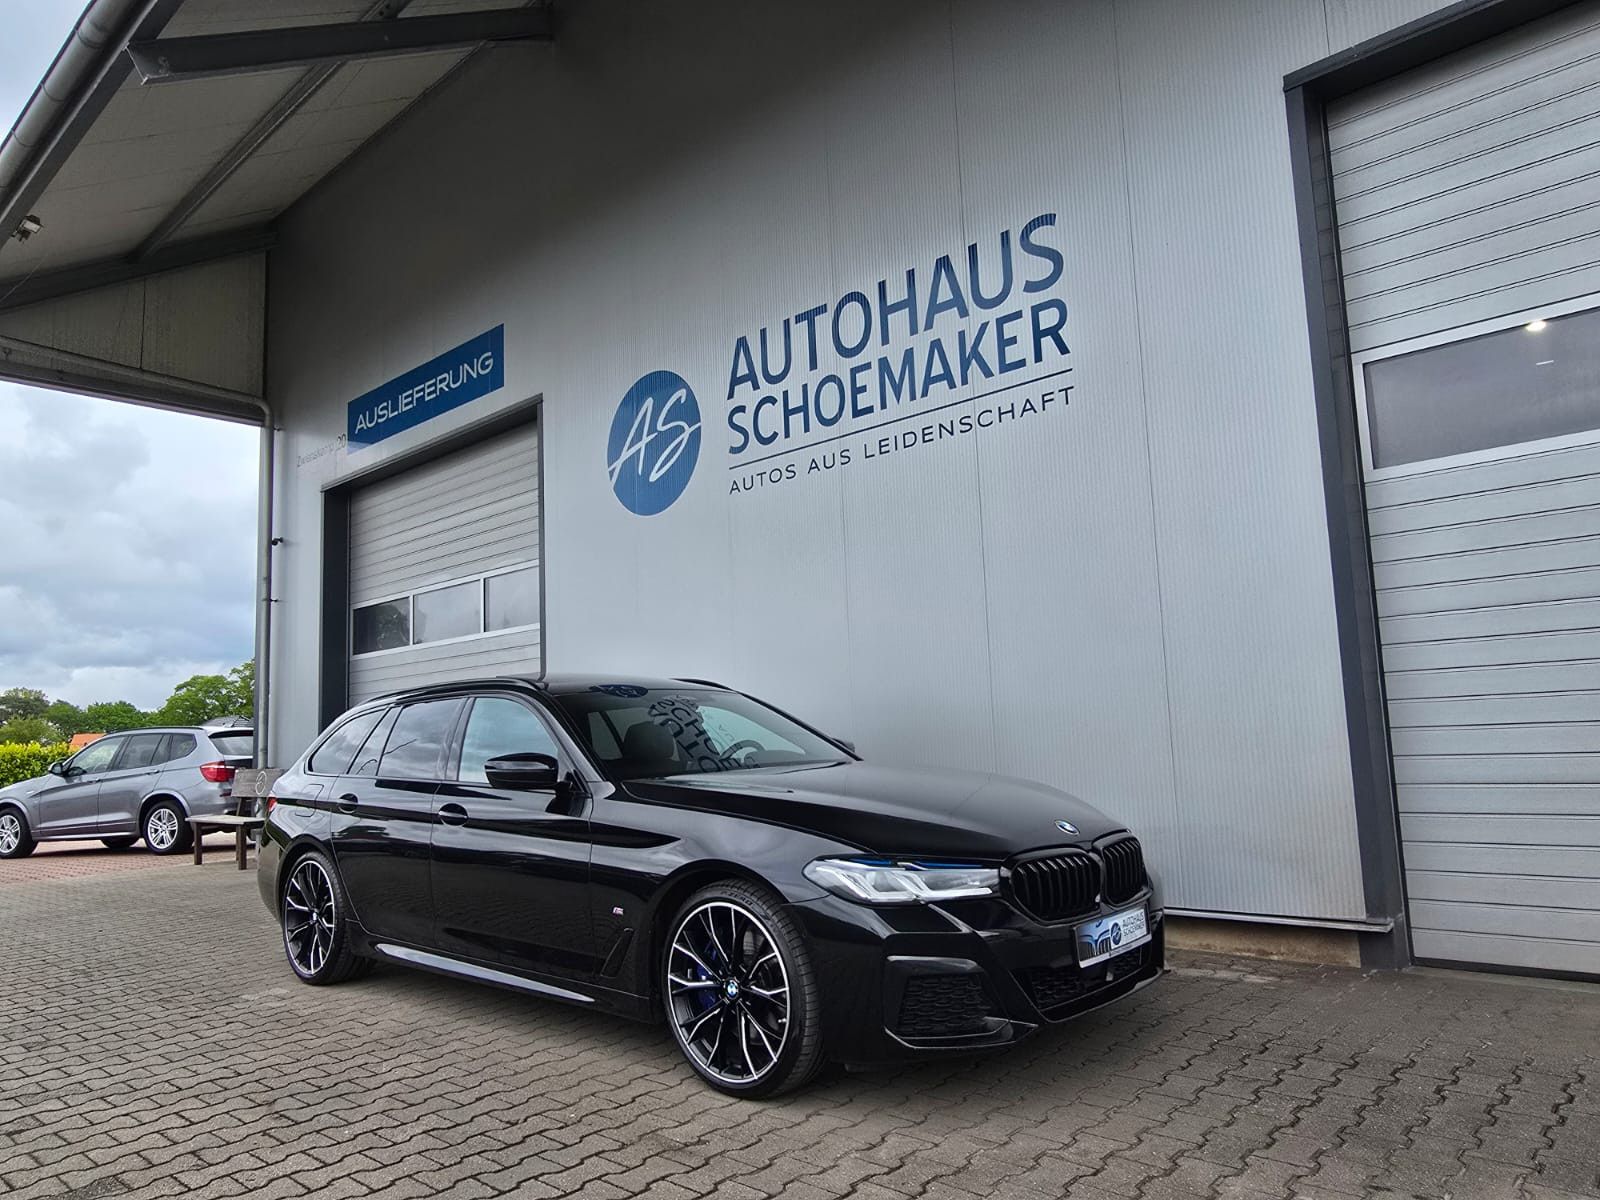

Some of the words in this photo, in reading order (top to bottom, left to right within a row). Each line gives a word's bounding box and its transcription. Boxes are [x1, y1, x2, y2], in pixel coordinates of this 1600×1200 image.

[728, 213, 1064, 400] AUTOHAUS
[355, 352, 494, 434] AUSLIEFERUNG
[727, 298, 1071, 455] SCHOEMAKER
[729, 464, 797, 494] AUTOS
[807, 449, 851, 473] AUS
[864, 386, 1074, 459] LEIDENSCHAFT
